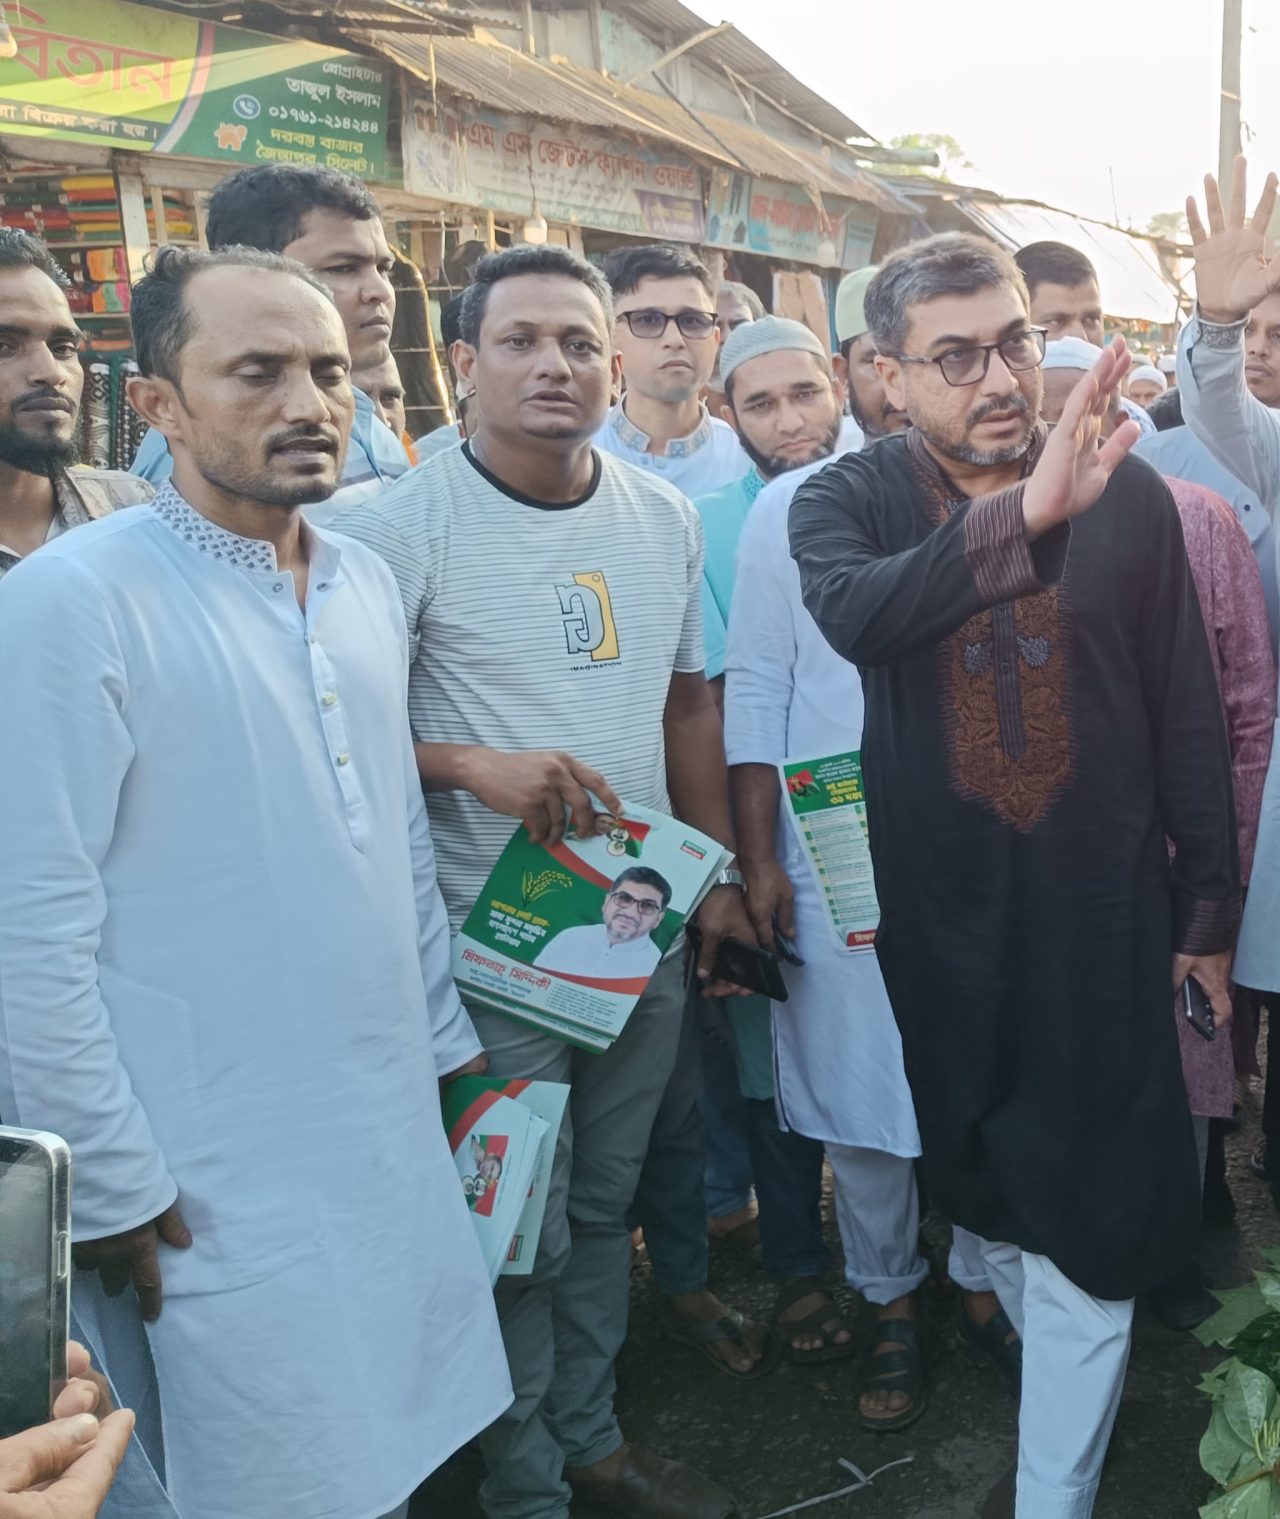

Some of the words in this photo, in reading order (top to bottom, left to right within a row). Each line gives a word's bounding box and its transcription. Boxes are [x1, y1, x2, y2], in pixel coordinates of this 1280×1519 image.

[322, 62, 382, 83] প্রোপ্রাইটার
[285, 77, 331, 103] তাজুল
[335, 84, 382, 109] ইসলাম
[22, 104, 78, 127] বিক্রয়
[81, 115, 118, 134] করা
[268, 106, 379, 134] ০১৭৬১-২১৪২৪৪
[320, 136, 363, 154] বাজার
